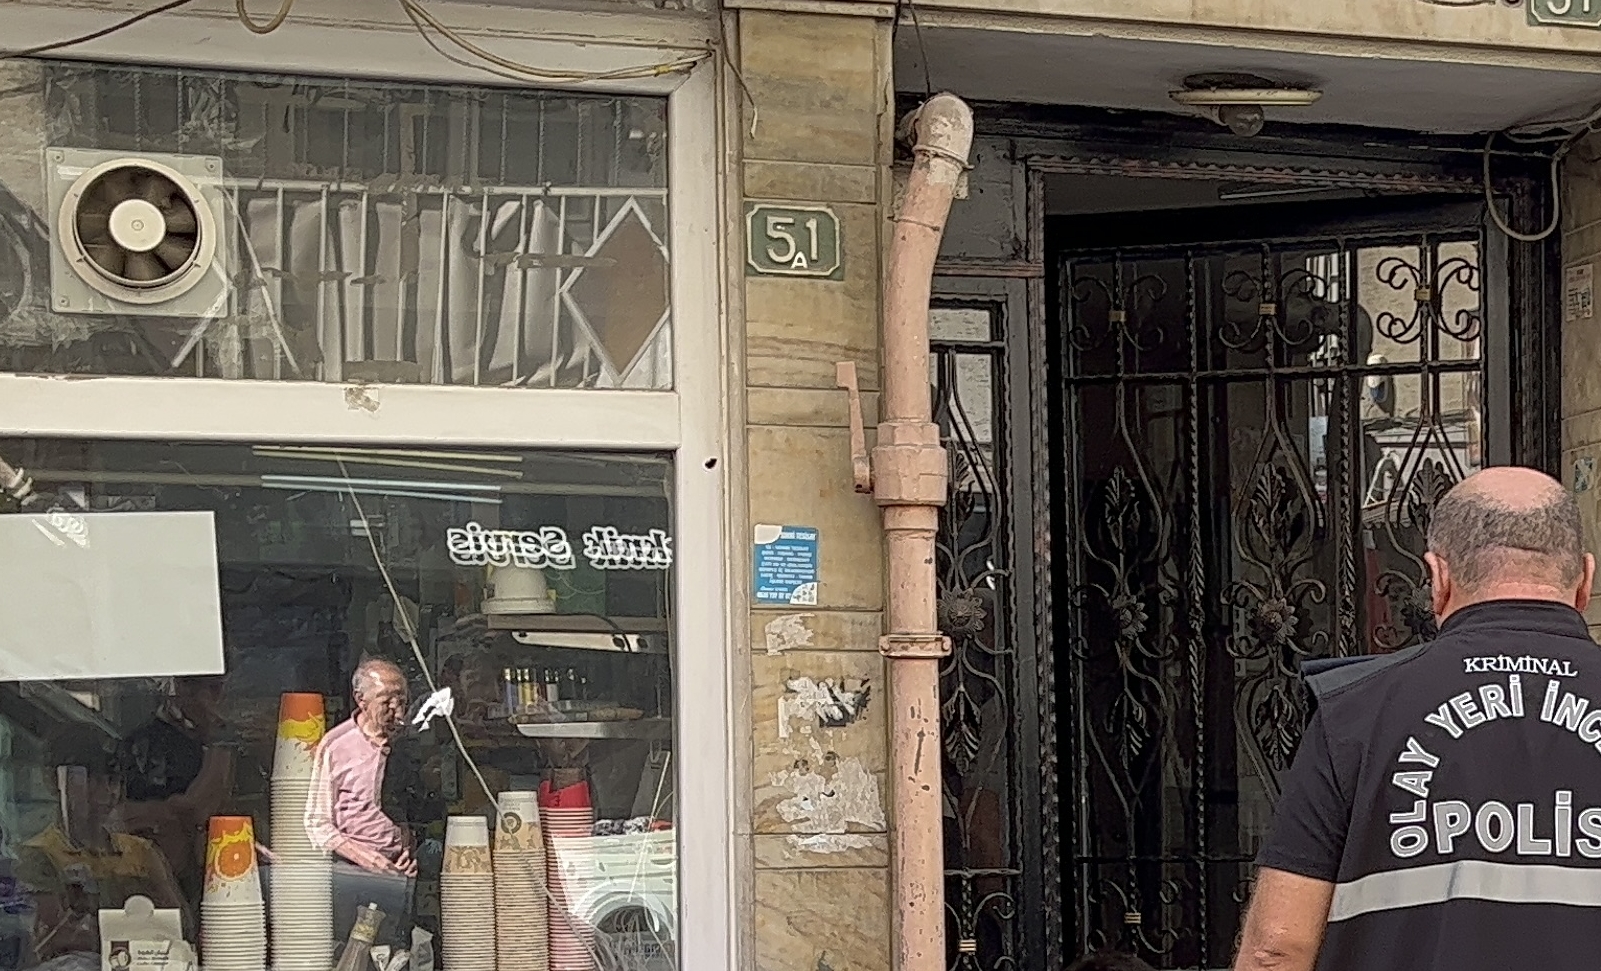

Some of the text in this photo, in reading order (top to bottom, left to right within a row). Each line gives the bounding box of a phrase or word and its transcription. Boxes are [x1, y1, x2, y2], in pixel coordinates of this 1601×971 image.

[766, 215, 818, 263] 51
[790, 251, 808, 269] A
[1463, 654, 1578, 678] KRİMİNAL
[1389, 736, 1441, 859] OLAY
[1424, 673, 1525, 740] YERİ
